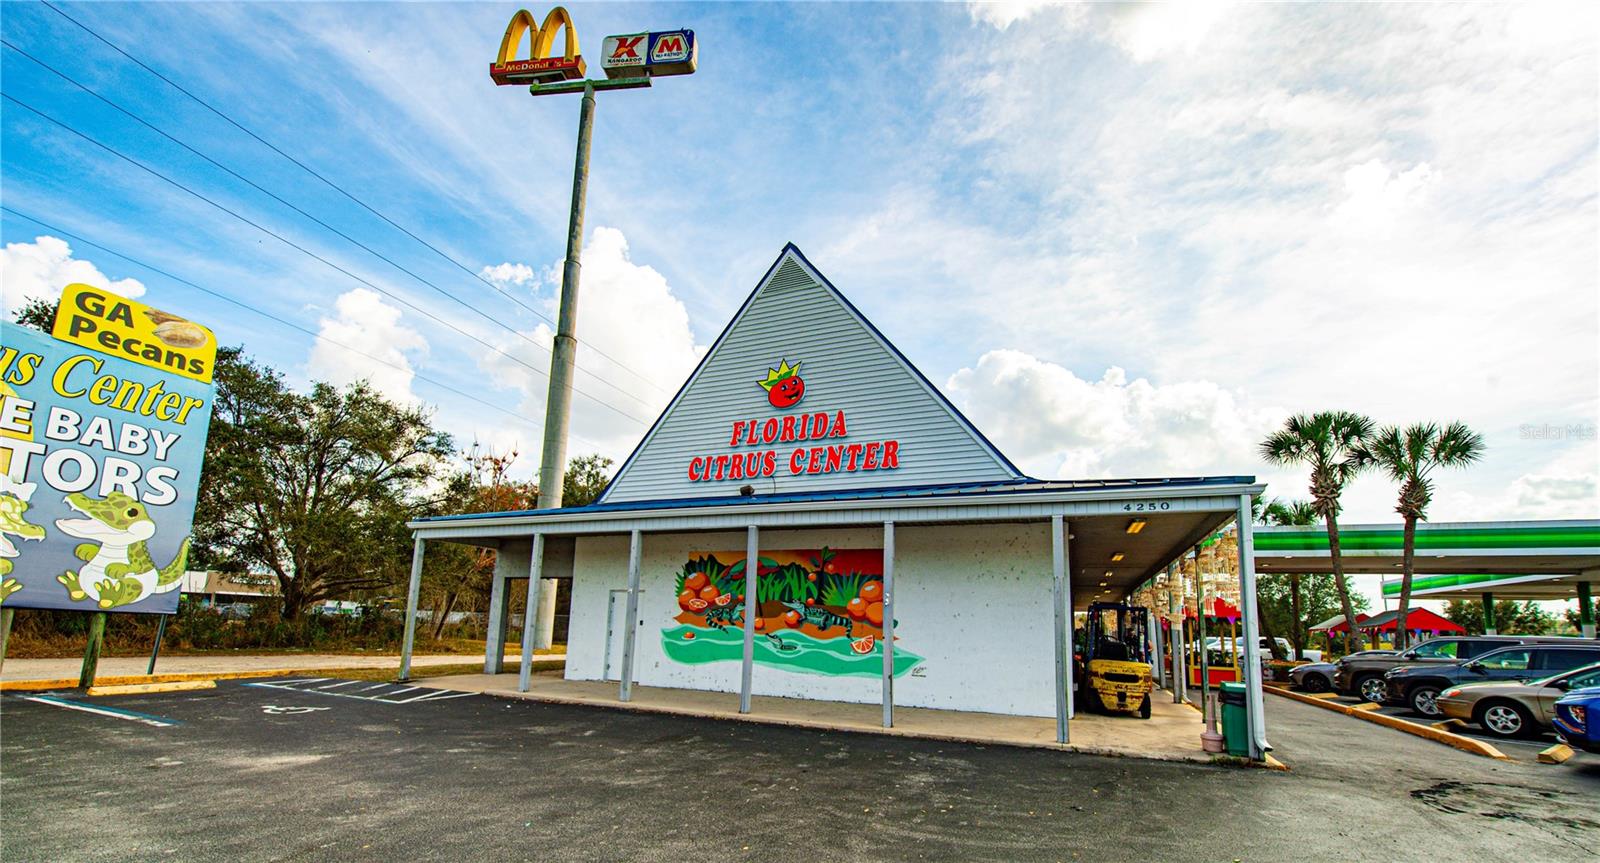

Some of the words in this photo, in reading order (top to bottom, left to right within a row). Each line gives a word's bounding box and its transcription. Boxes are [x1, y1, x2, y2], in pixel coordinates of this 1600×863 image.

[607, 57, 643, 65] KANGAROO
[611, 36, 646, 58] K
[657, 37, 683, 54] M
[506, 60, 562, 72] McDonal's
[75, 291, 135, 329] GA
[69, 315, 205, 376] Pecans
[52, 354, 204, 425] Center
[45, 406, 180, 461] BABY
[729, 409, 848, 447] FLORIDA
[688, 450, 776, 482] CITRUS
[789, 439, 900, 475] CENTER
[1123, 501, 1170, 511] 4250
